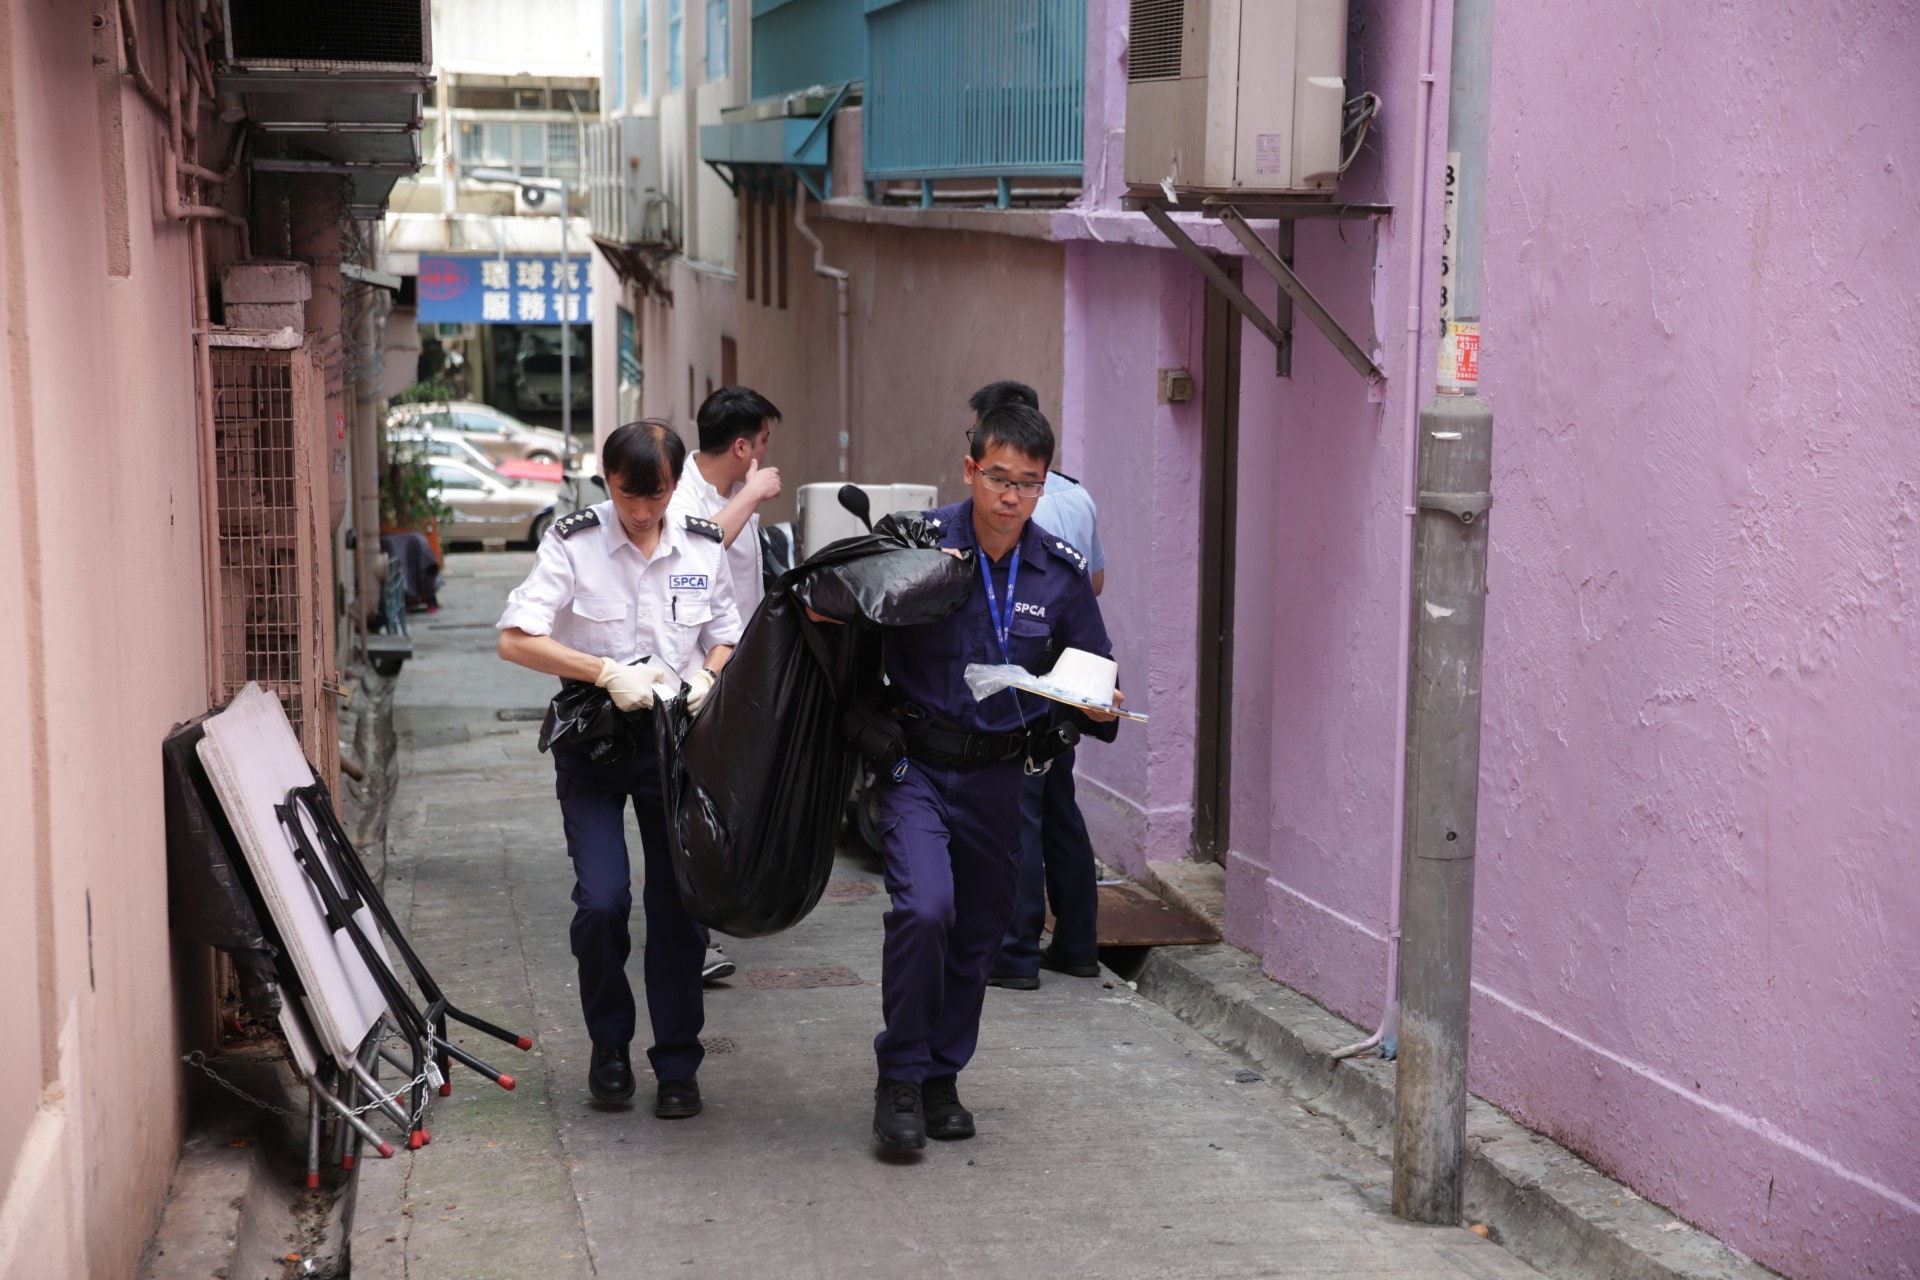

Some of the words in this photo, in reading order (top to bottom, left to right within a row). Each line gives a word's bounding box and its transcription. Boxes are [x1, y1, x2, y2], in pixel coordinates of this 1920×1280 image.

[481, 260, 592, 290] 環球汽
[482, 291, 593, 321] 服務有
[673, 577, 705, 587] SPCA
[1014, 601, 1046, 617] SPCA
